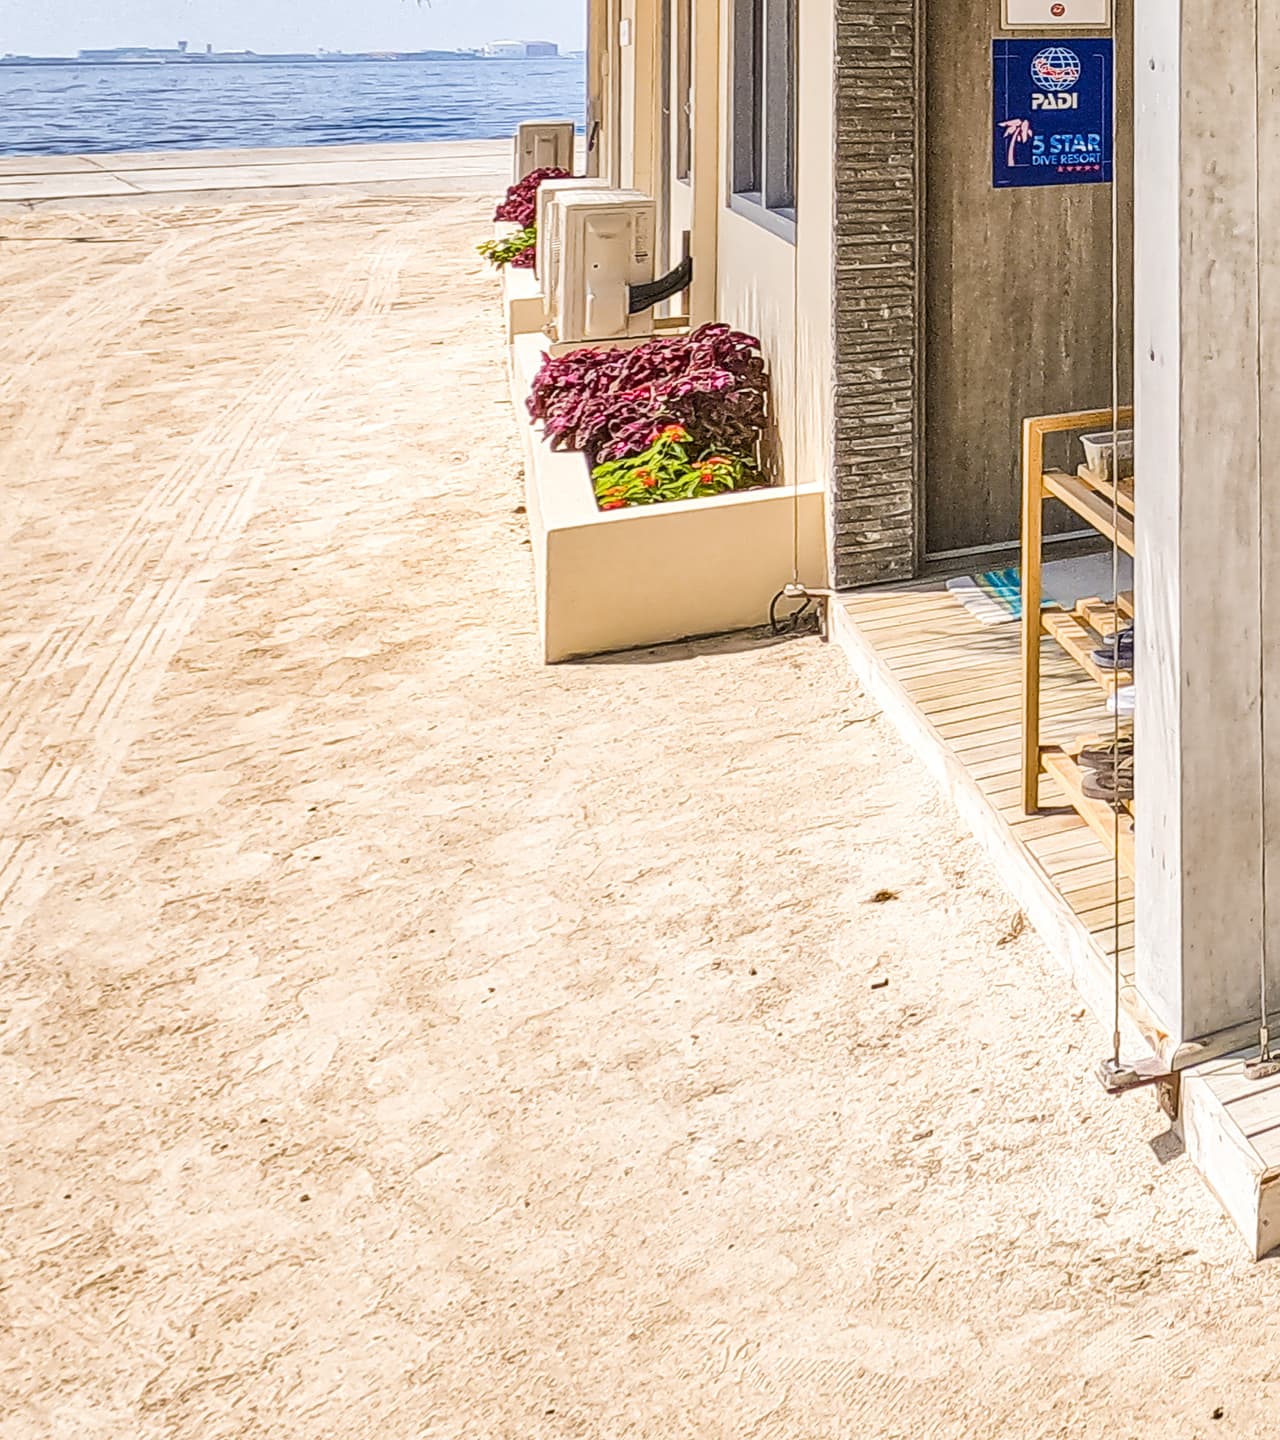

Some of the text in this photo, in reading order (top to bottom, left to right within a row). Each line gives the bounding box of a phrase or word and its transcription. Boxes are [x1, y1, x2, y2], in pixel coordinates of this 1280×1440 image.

[1031, 92, 1078, 110] PADI
[1032, 133, 1101, 155] 5 STAR
[1032, 152, 1101, 166] DIVE RESORT
